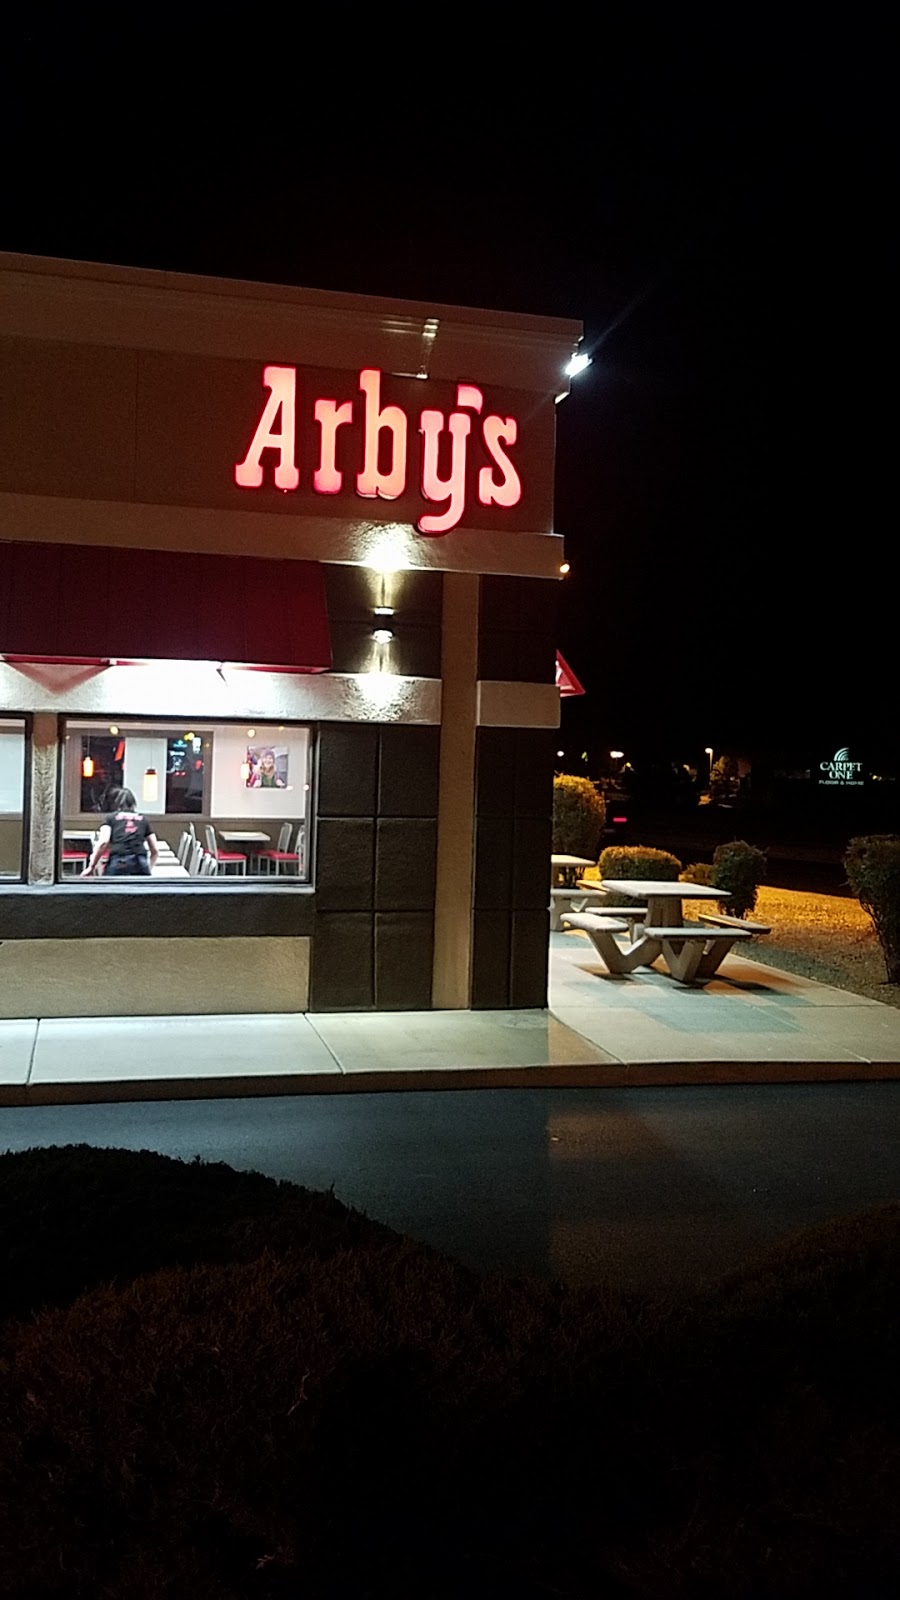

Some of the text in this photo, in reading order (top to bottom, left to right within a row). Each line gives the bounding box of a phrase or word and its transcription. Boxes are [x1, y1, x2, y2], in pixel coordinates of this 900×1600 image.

[234, 365, 522, 535] Arby's
[819, 761, 863, 772] CARPET
[829, 770, 853, 780] ONE
